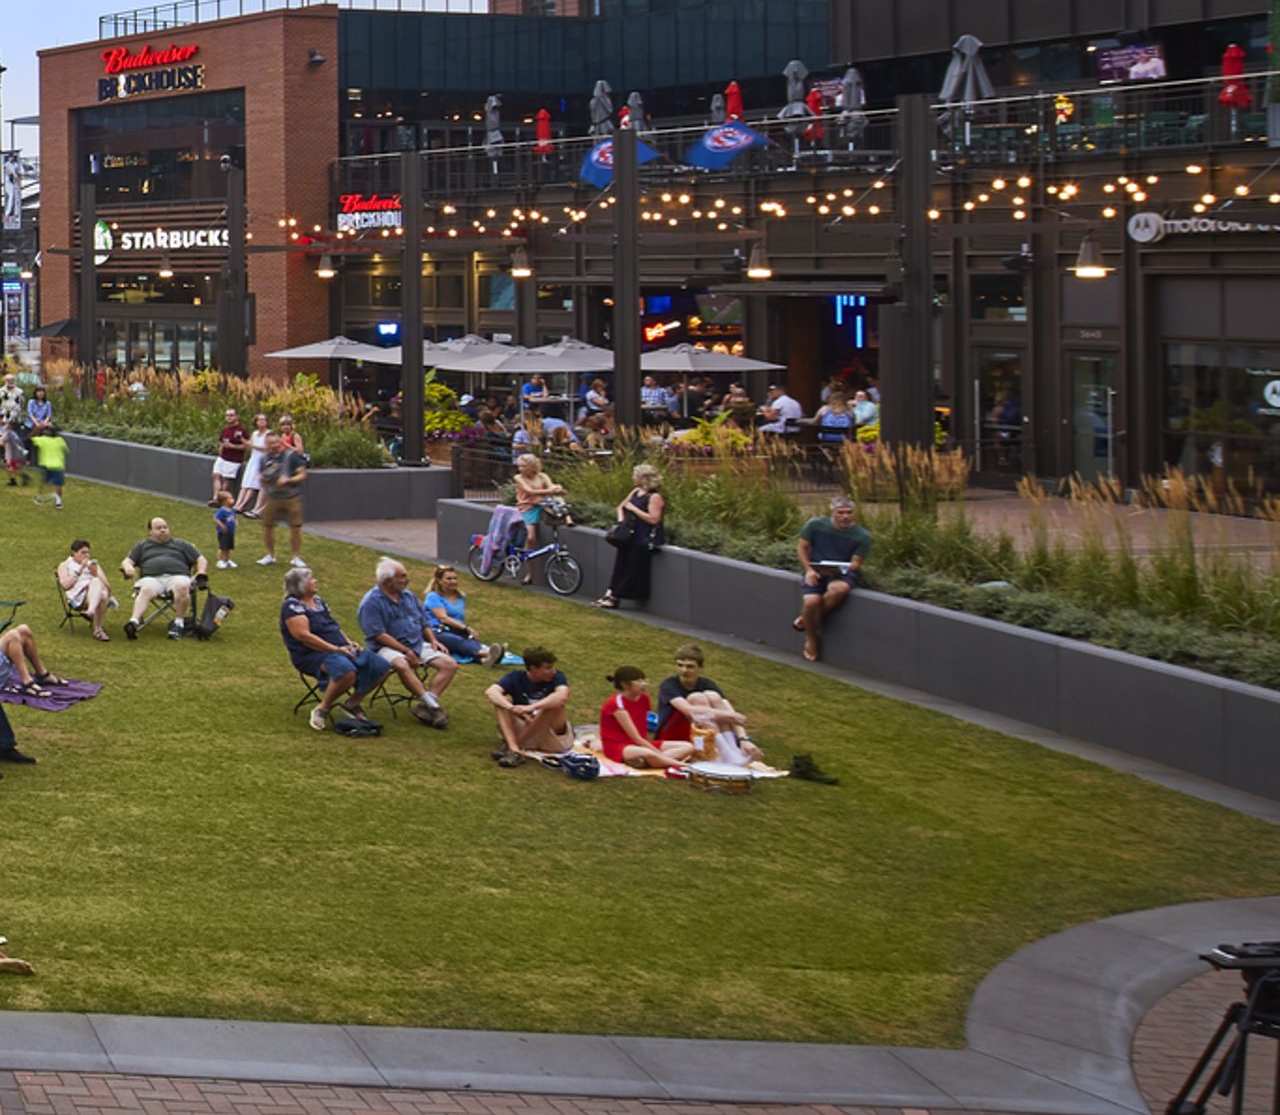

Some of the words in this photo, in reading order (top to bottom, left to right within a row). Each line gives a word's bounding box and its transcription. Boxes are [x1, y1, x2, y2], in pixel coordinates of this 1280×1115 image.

[101, 43, 198, 74] Budweiser
[339, 194, 401, 213] Budweis
[337, 211, 402, 231] BRICKHOU
[121, 229, 230, 250] STARBUCKS
